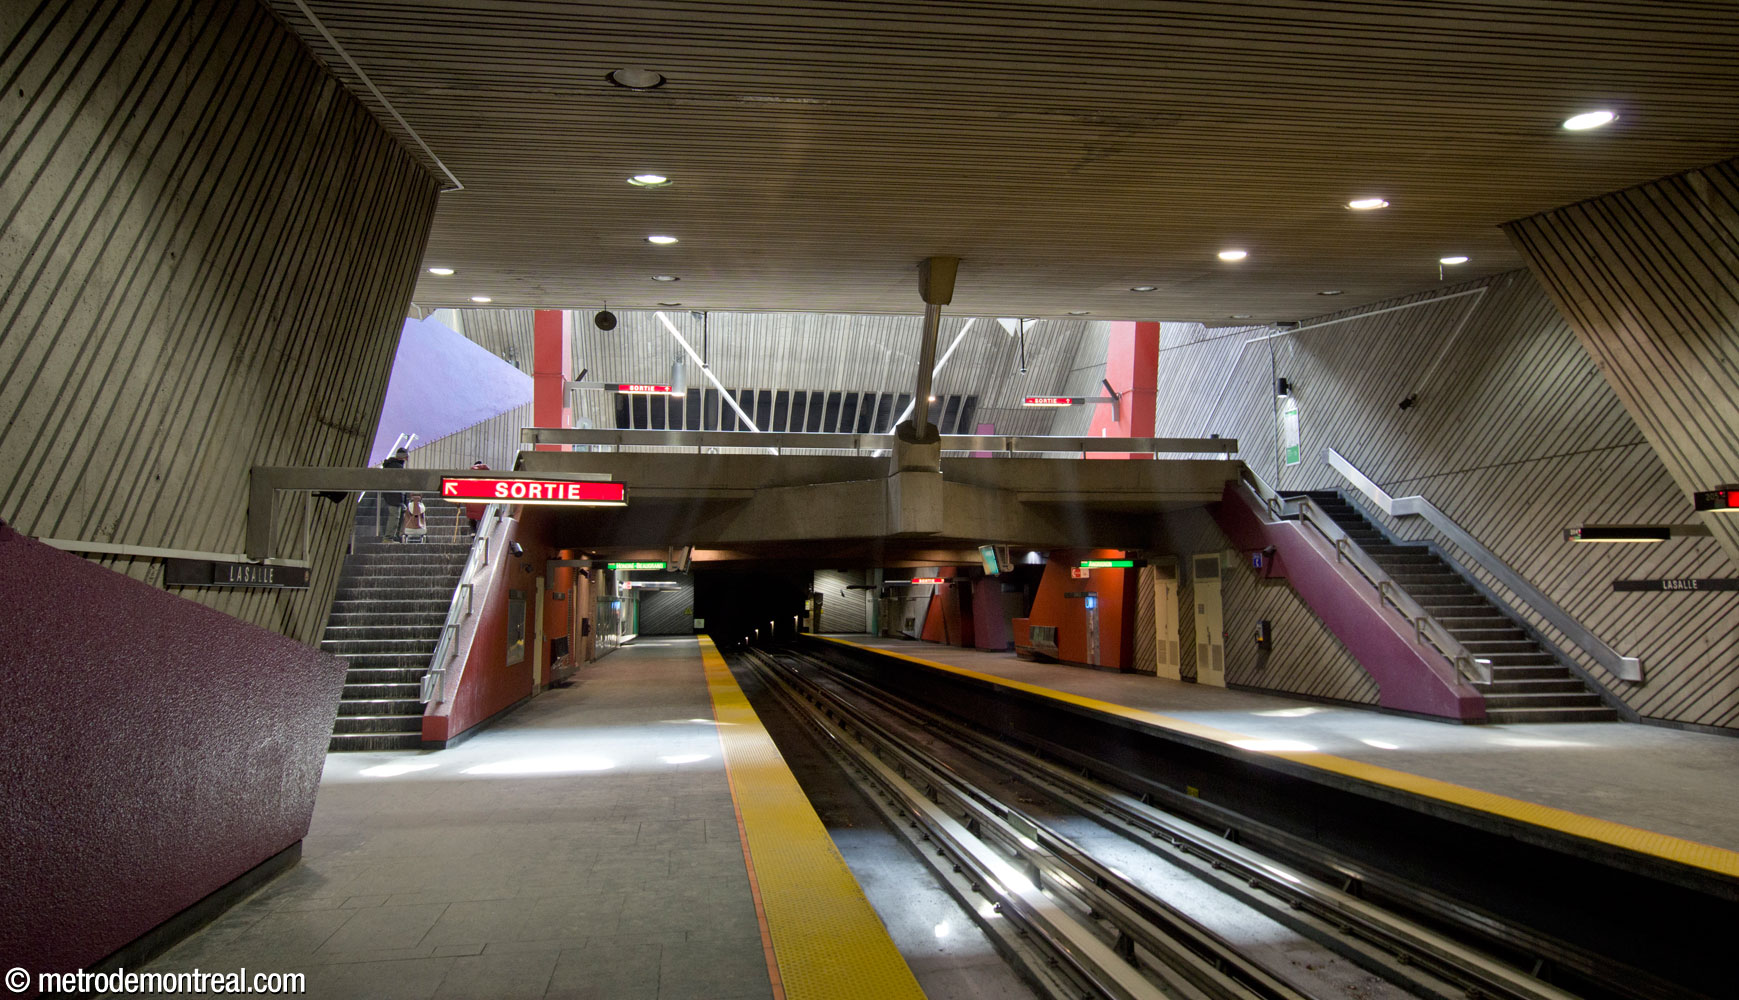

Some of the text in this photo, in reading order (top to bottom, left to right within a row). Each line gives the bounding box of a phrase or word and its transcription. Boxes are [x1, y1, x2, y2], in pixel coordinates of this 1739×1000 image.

[494, 482, 581, 500] SORTIE
[229, 565, 274, 584] LASALLE
[1662, 579, 1698, 590] LASALLE
